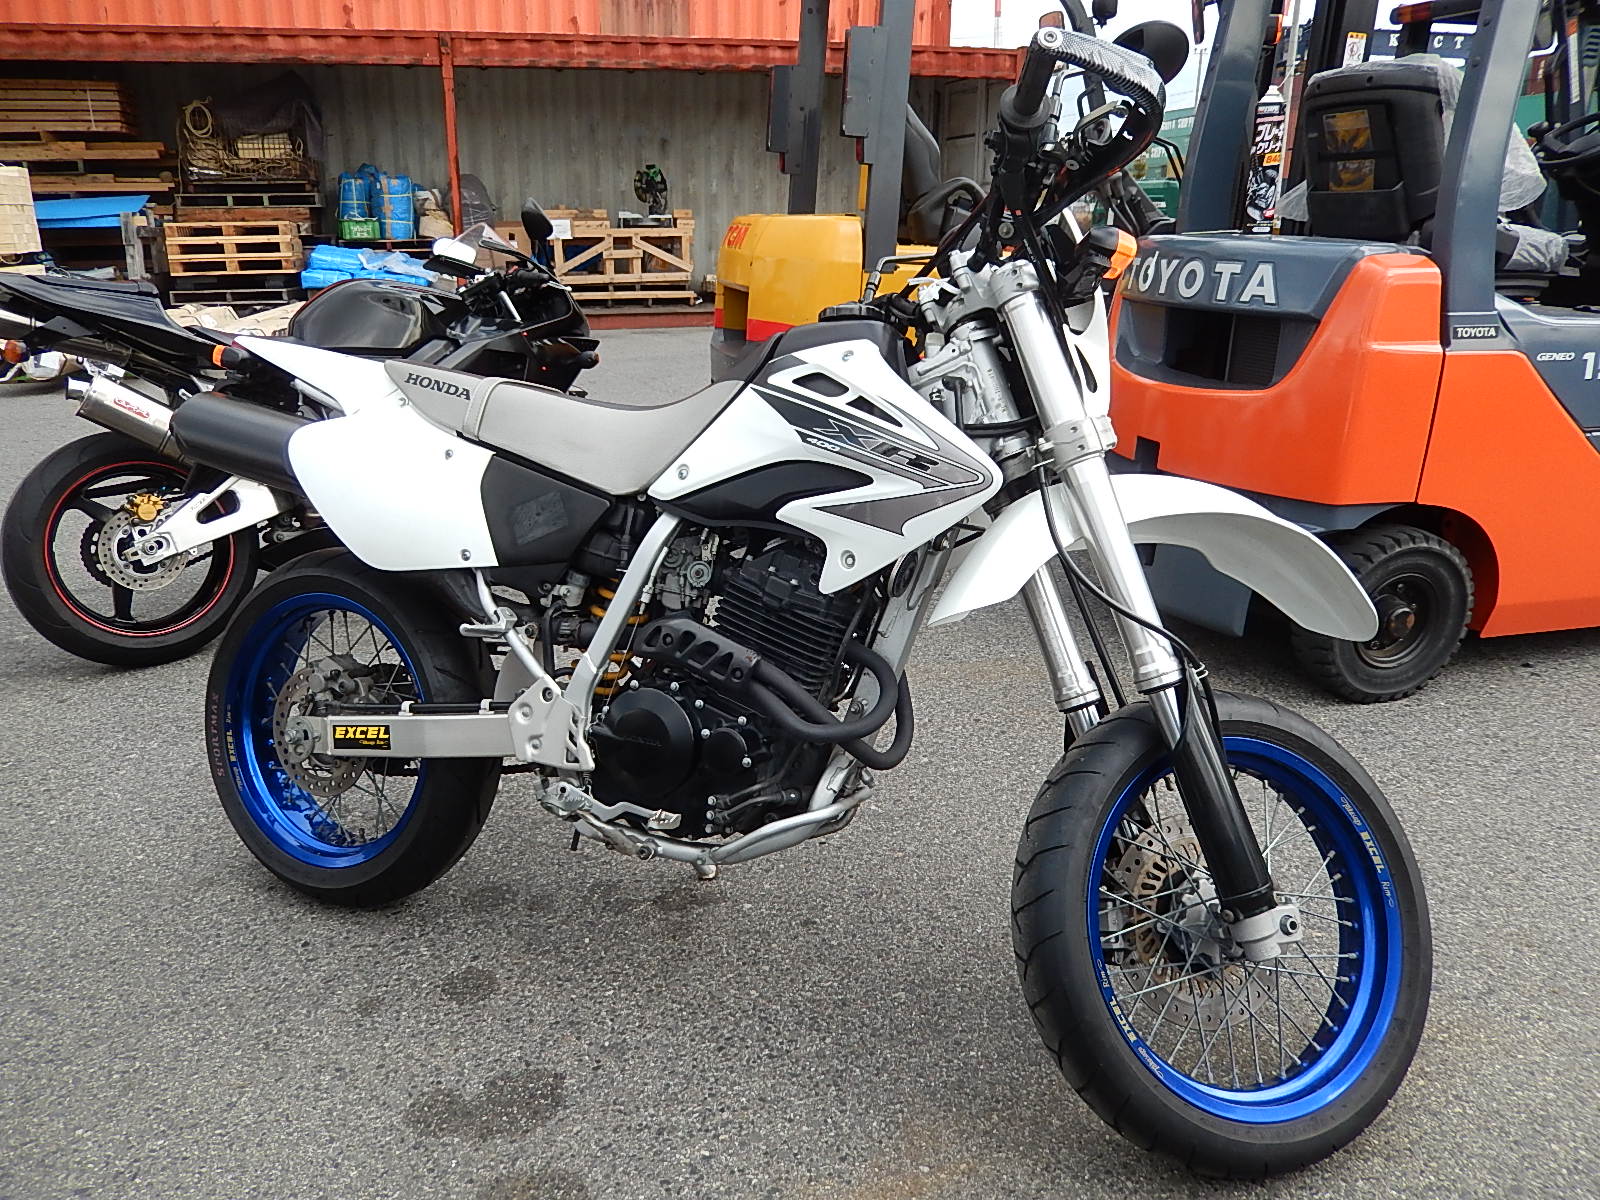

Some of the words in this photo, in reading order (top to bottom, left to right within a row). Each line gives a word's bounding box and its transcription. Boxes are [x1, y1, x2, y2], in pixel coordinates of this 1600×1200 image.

[1127, 257, 1276, 304] TOYOTA
[1456, 327, 1496, 338] TOYOTA
[1536, 352, 1576, 362] GENEO
[404, 372, 471, 401] HONDA
[806, 437, 841, 455] 400
[335, 726, 389, 739] EXCEL
[1360, 831, 1385, 874] EXCEL
[1109, 995, 1138, 1043] EXCEL
